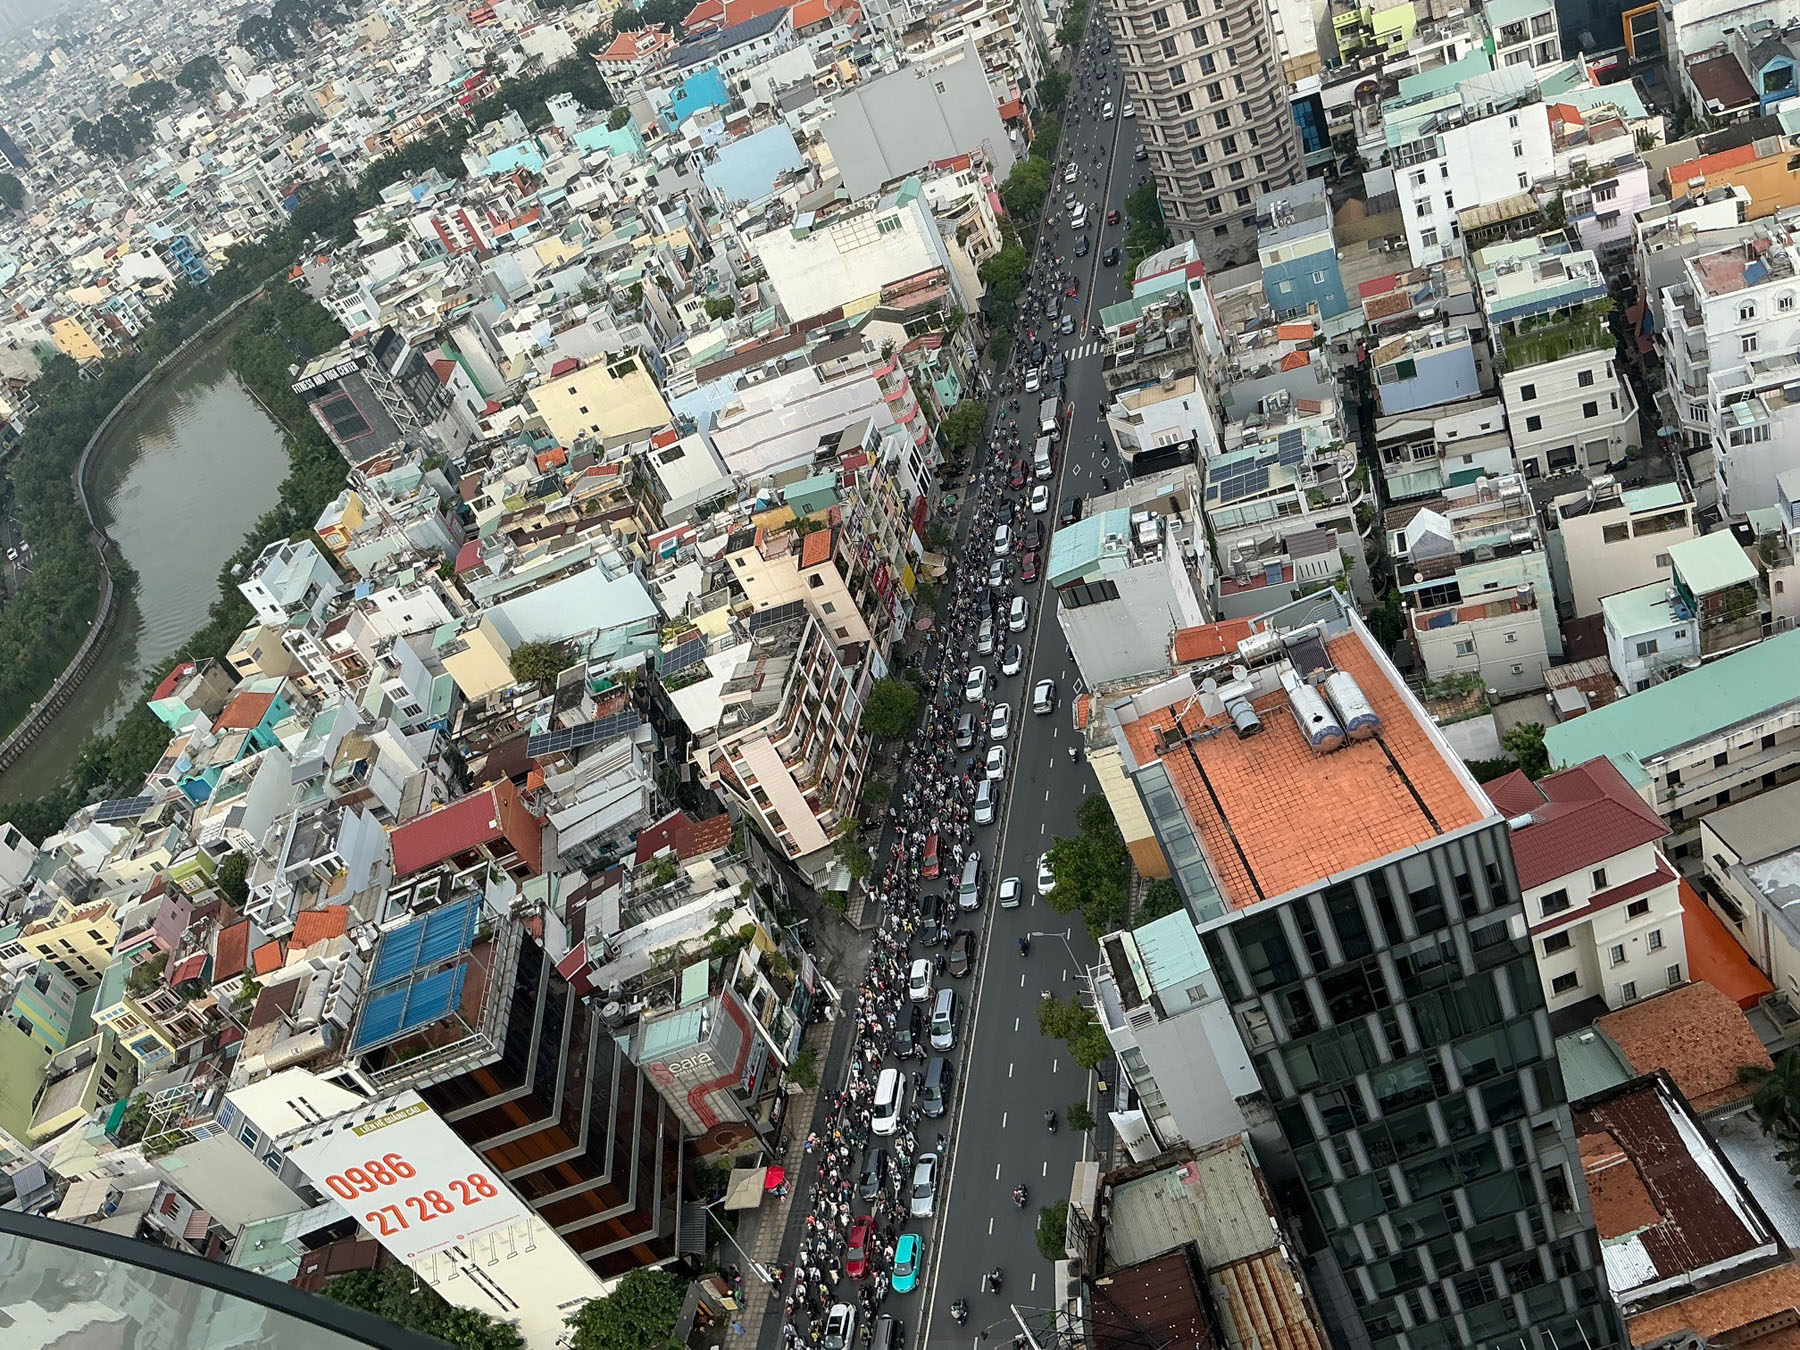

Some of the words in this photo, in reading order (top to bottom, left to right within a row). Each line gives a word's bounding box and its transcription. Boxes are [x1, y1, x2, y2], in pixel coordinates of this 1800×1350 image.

[291, 378, 315, 394] FITNESS
[312, 373, 326, 386] AND
[322, 368, 340, 382] YOGA
[336, 361, 359, 376] CENTER
[648, 1052, 712, 1086] Seara
[359, 1122, 377, 1133] LIÊN
[325, 1152, 417, 1200] 0986
[365, 1203, 410, 1237] 27
[405, 1189, 455, 1222] 28
[448, 1173, 498, 1206] 28
